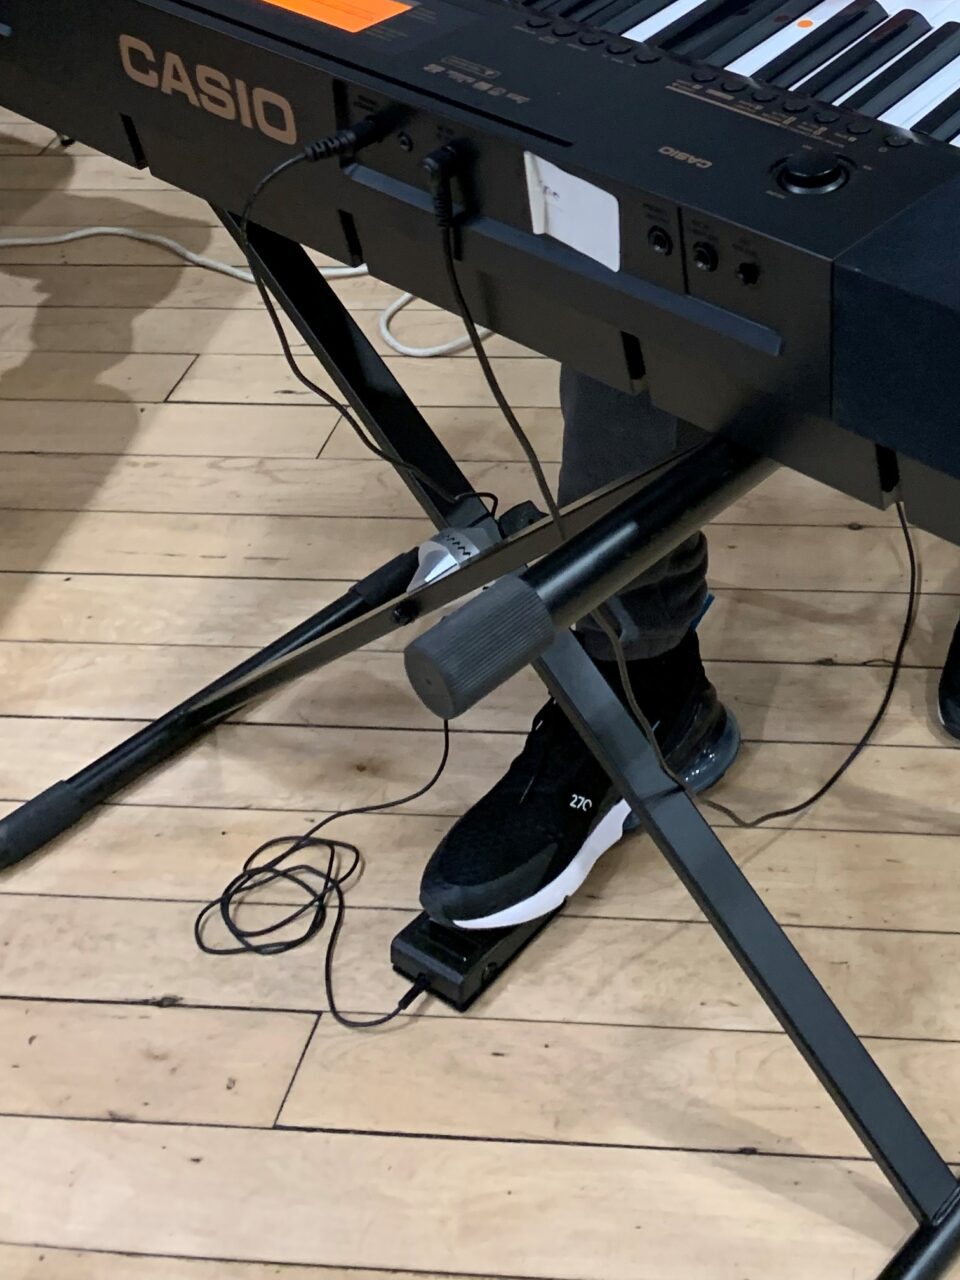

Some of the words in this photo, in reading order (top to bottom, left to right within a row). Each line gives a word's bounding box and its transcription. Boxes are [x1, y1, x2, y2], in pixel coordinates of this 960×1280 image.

[119, 33, 297, 145] CASIO
[658, 146, 713, 168] CASIO
[570, 793, 592, 812] 270
